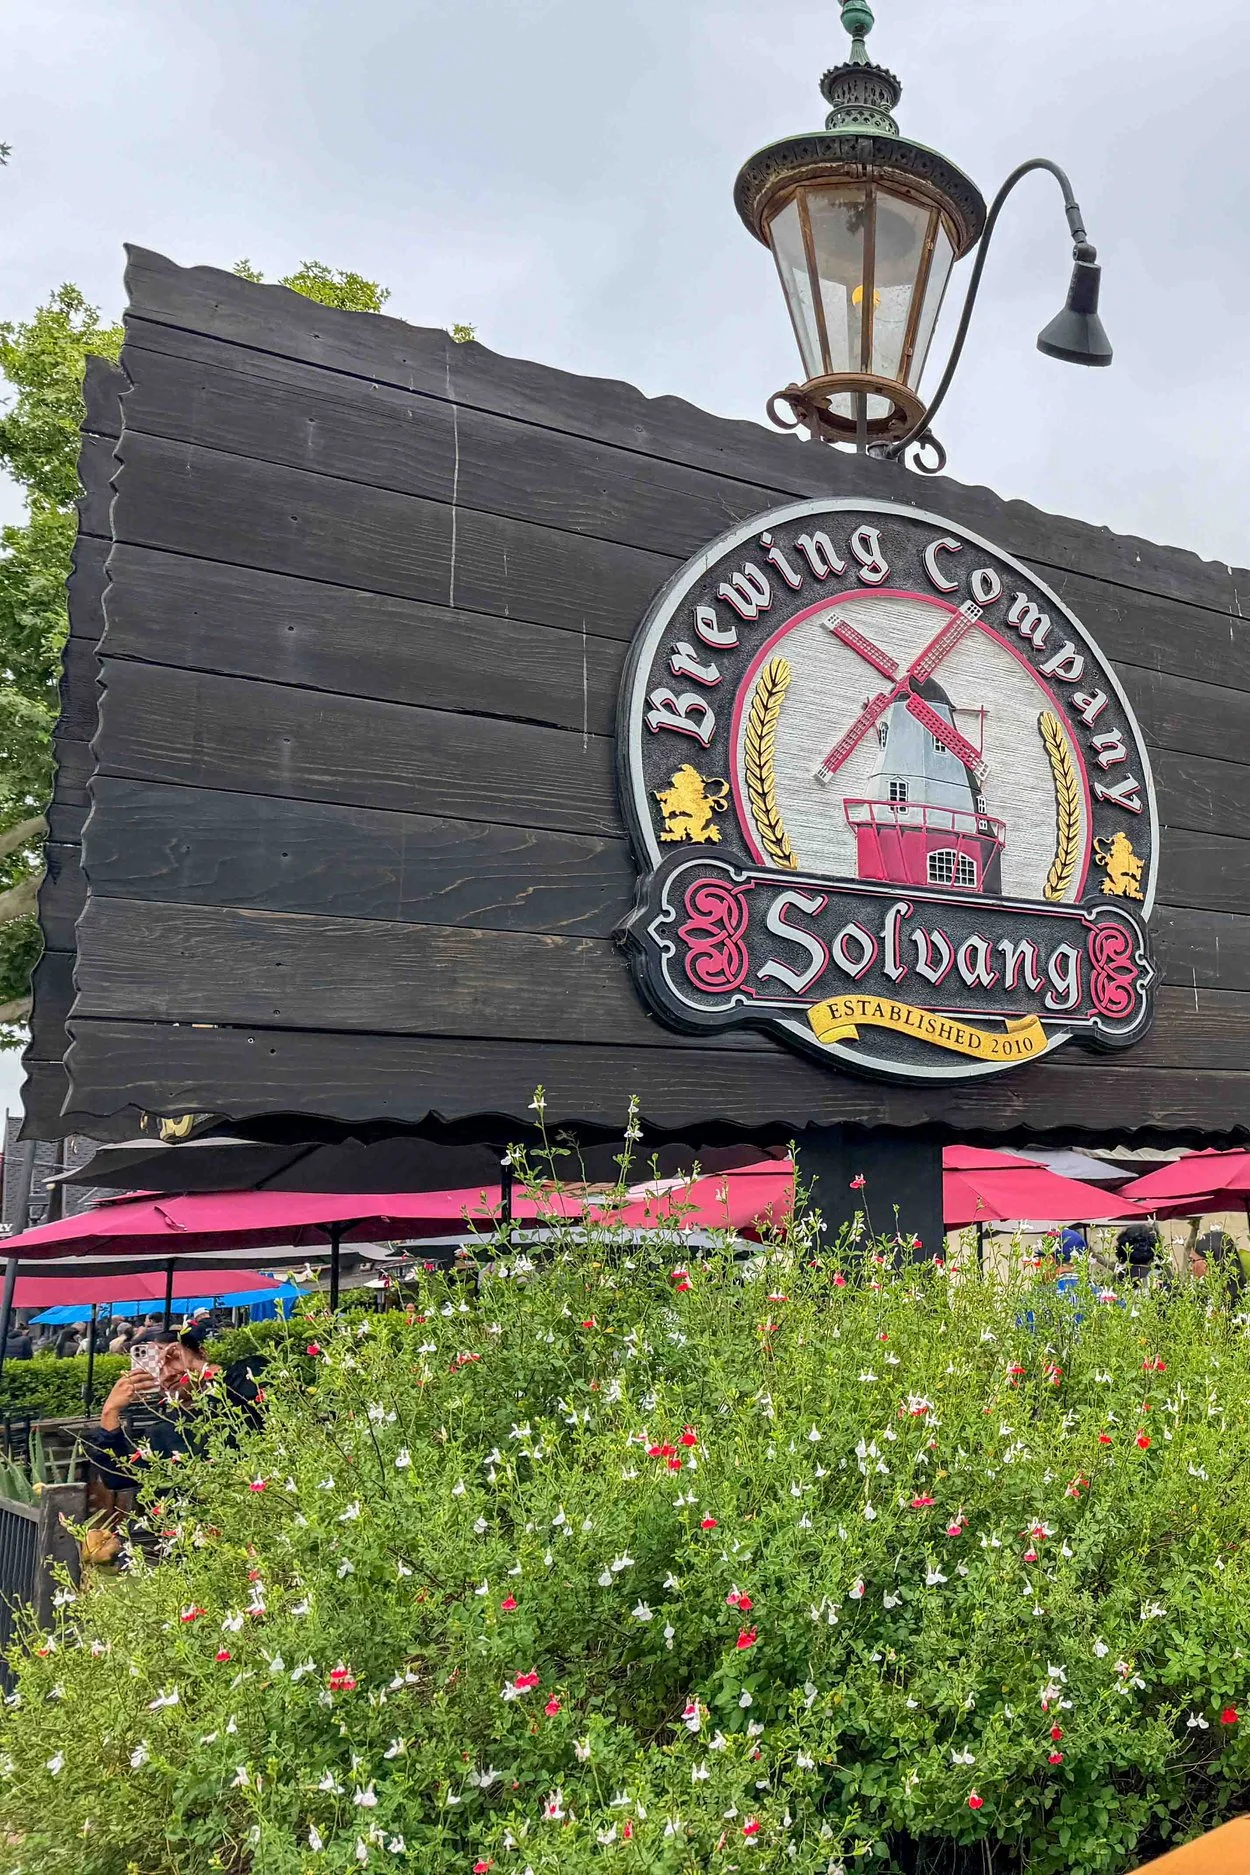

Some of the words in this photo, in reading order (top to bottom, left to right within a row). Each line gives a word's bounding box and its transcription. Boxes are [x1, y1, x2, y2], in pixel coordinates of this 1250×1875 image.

[645, 523, 891, 748] Brewing
[921, 534, 1143, 815] Company
[756, 889, 1081, 1013] Solvang
[829, 1001, 982, 1051] ESTABLISHED
[990, 1035, 1033, 1055] 2010
